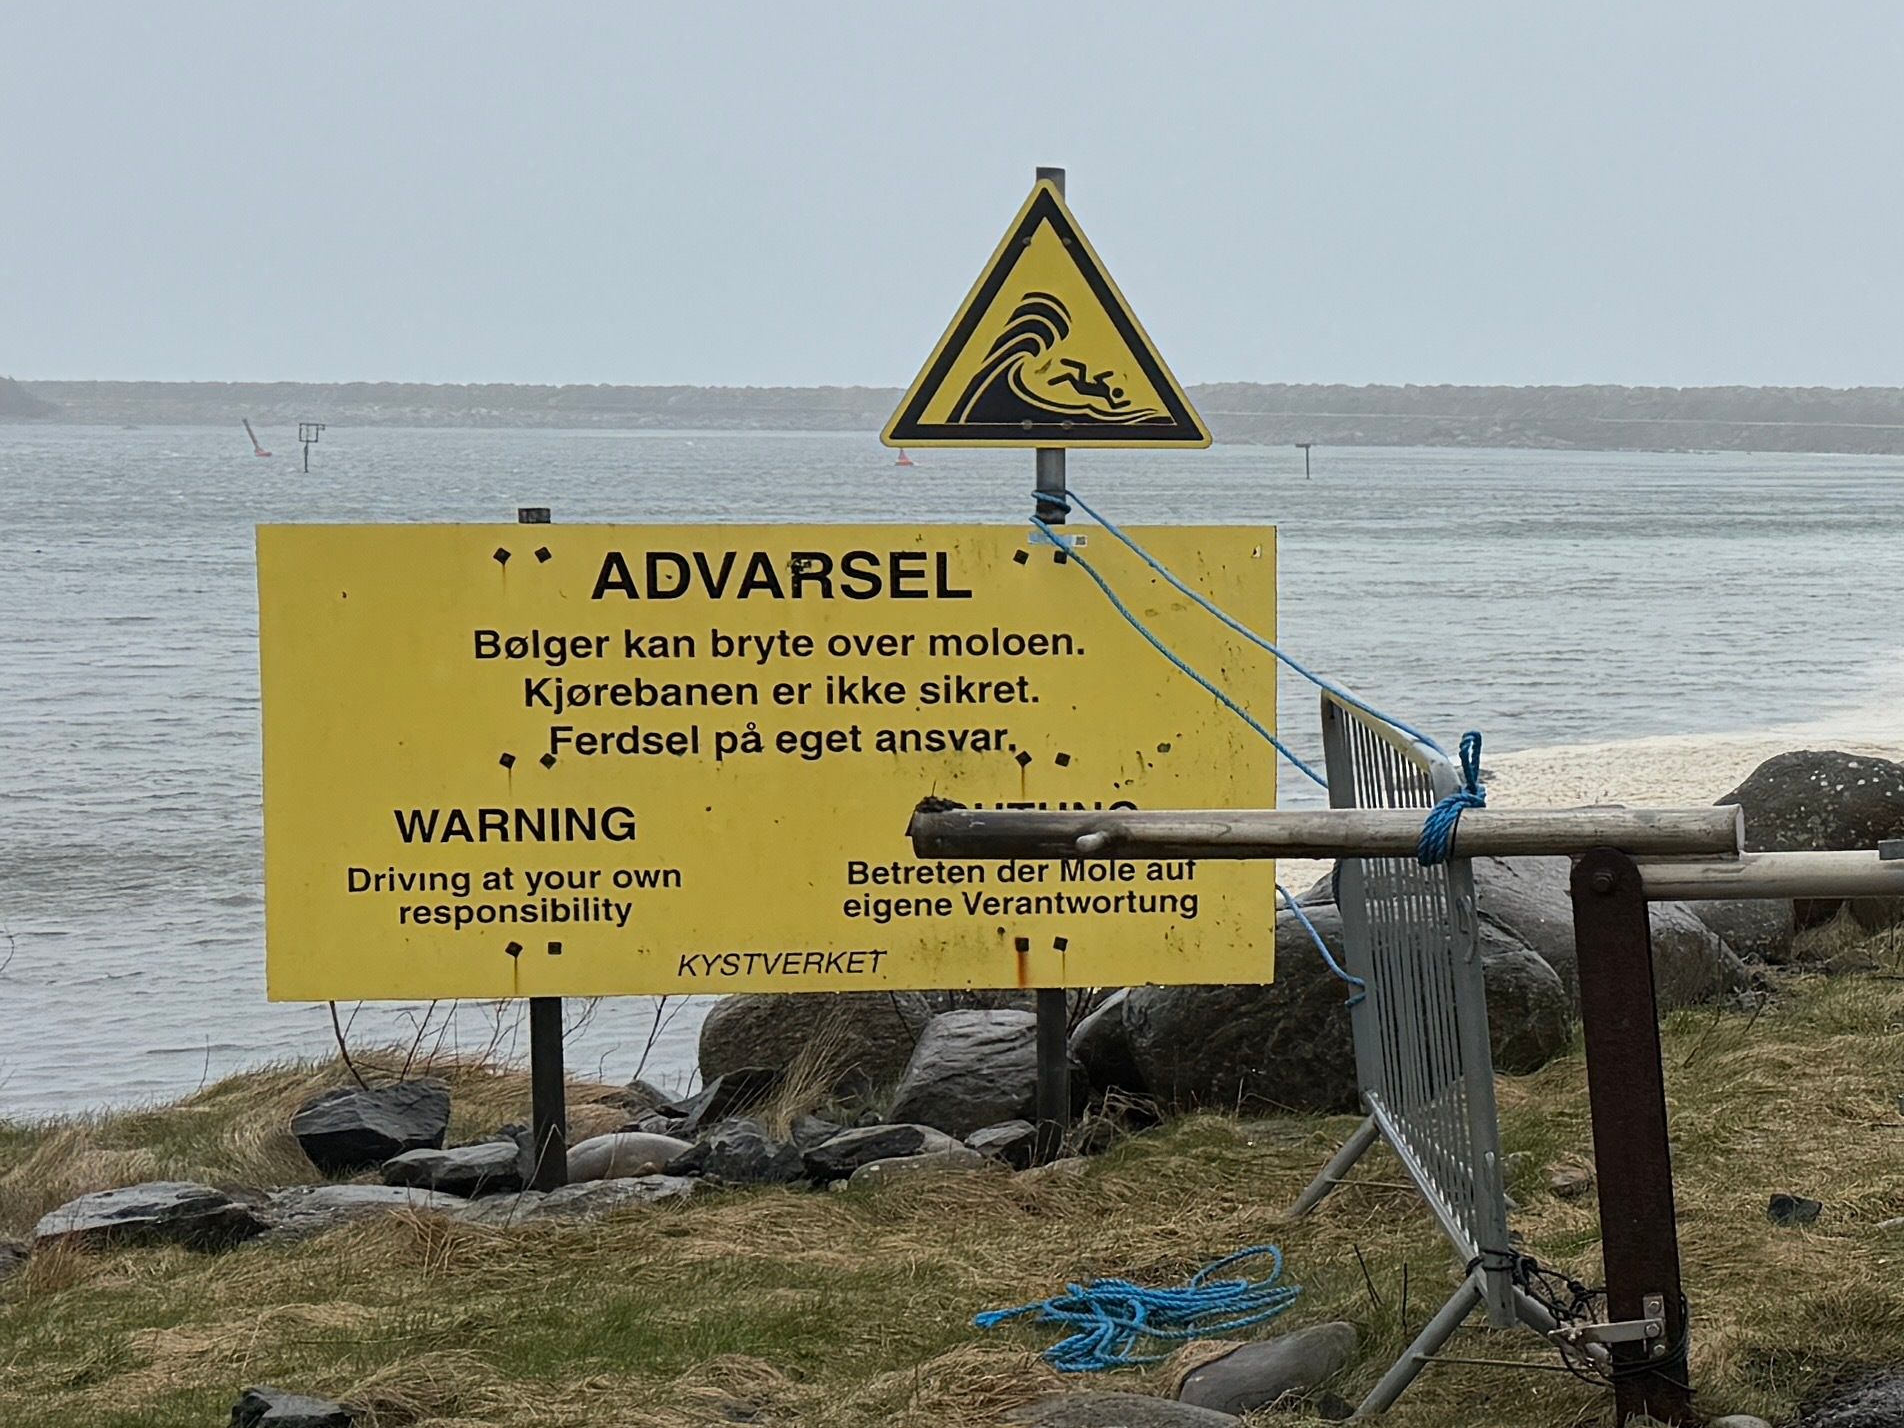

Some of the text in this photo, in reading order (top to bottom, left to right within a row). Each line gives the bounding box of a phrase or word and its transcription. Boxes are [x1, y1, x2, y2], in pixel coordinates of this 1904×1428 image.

[592, 550, 973, 601] ADVARSEL
[474, 627, 1085, 666] Bølger kan bryte over moloen.
[524, 674, 1040, 715] Kjørebanen er ikke sikret.
[550, 721, 1017, 762] Ferdsel på eget ansvar.
[393, 806, 637, 843] WARNING
[348, 866, 682, 898] Driving at your own
[848, 859, 1197, 885] Betreten der Mole auf
[399, 897, 633, 931] responsibility
[843, 890, 1199, 924] eigene Verantwortung
[677, 949, 888, 977] KYSTVERKET
